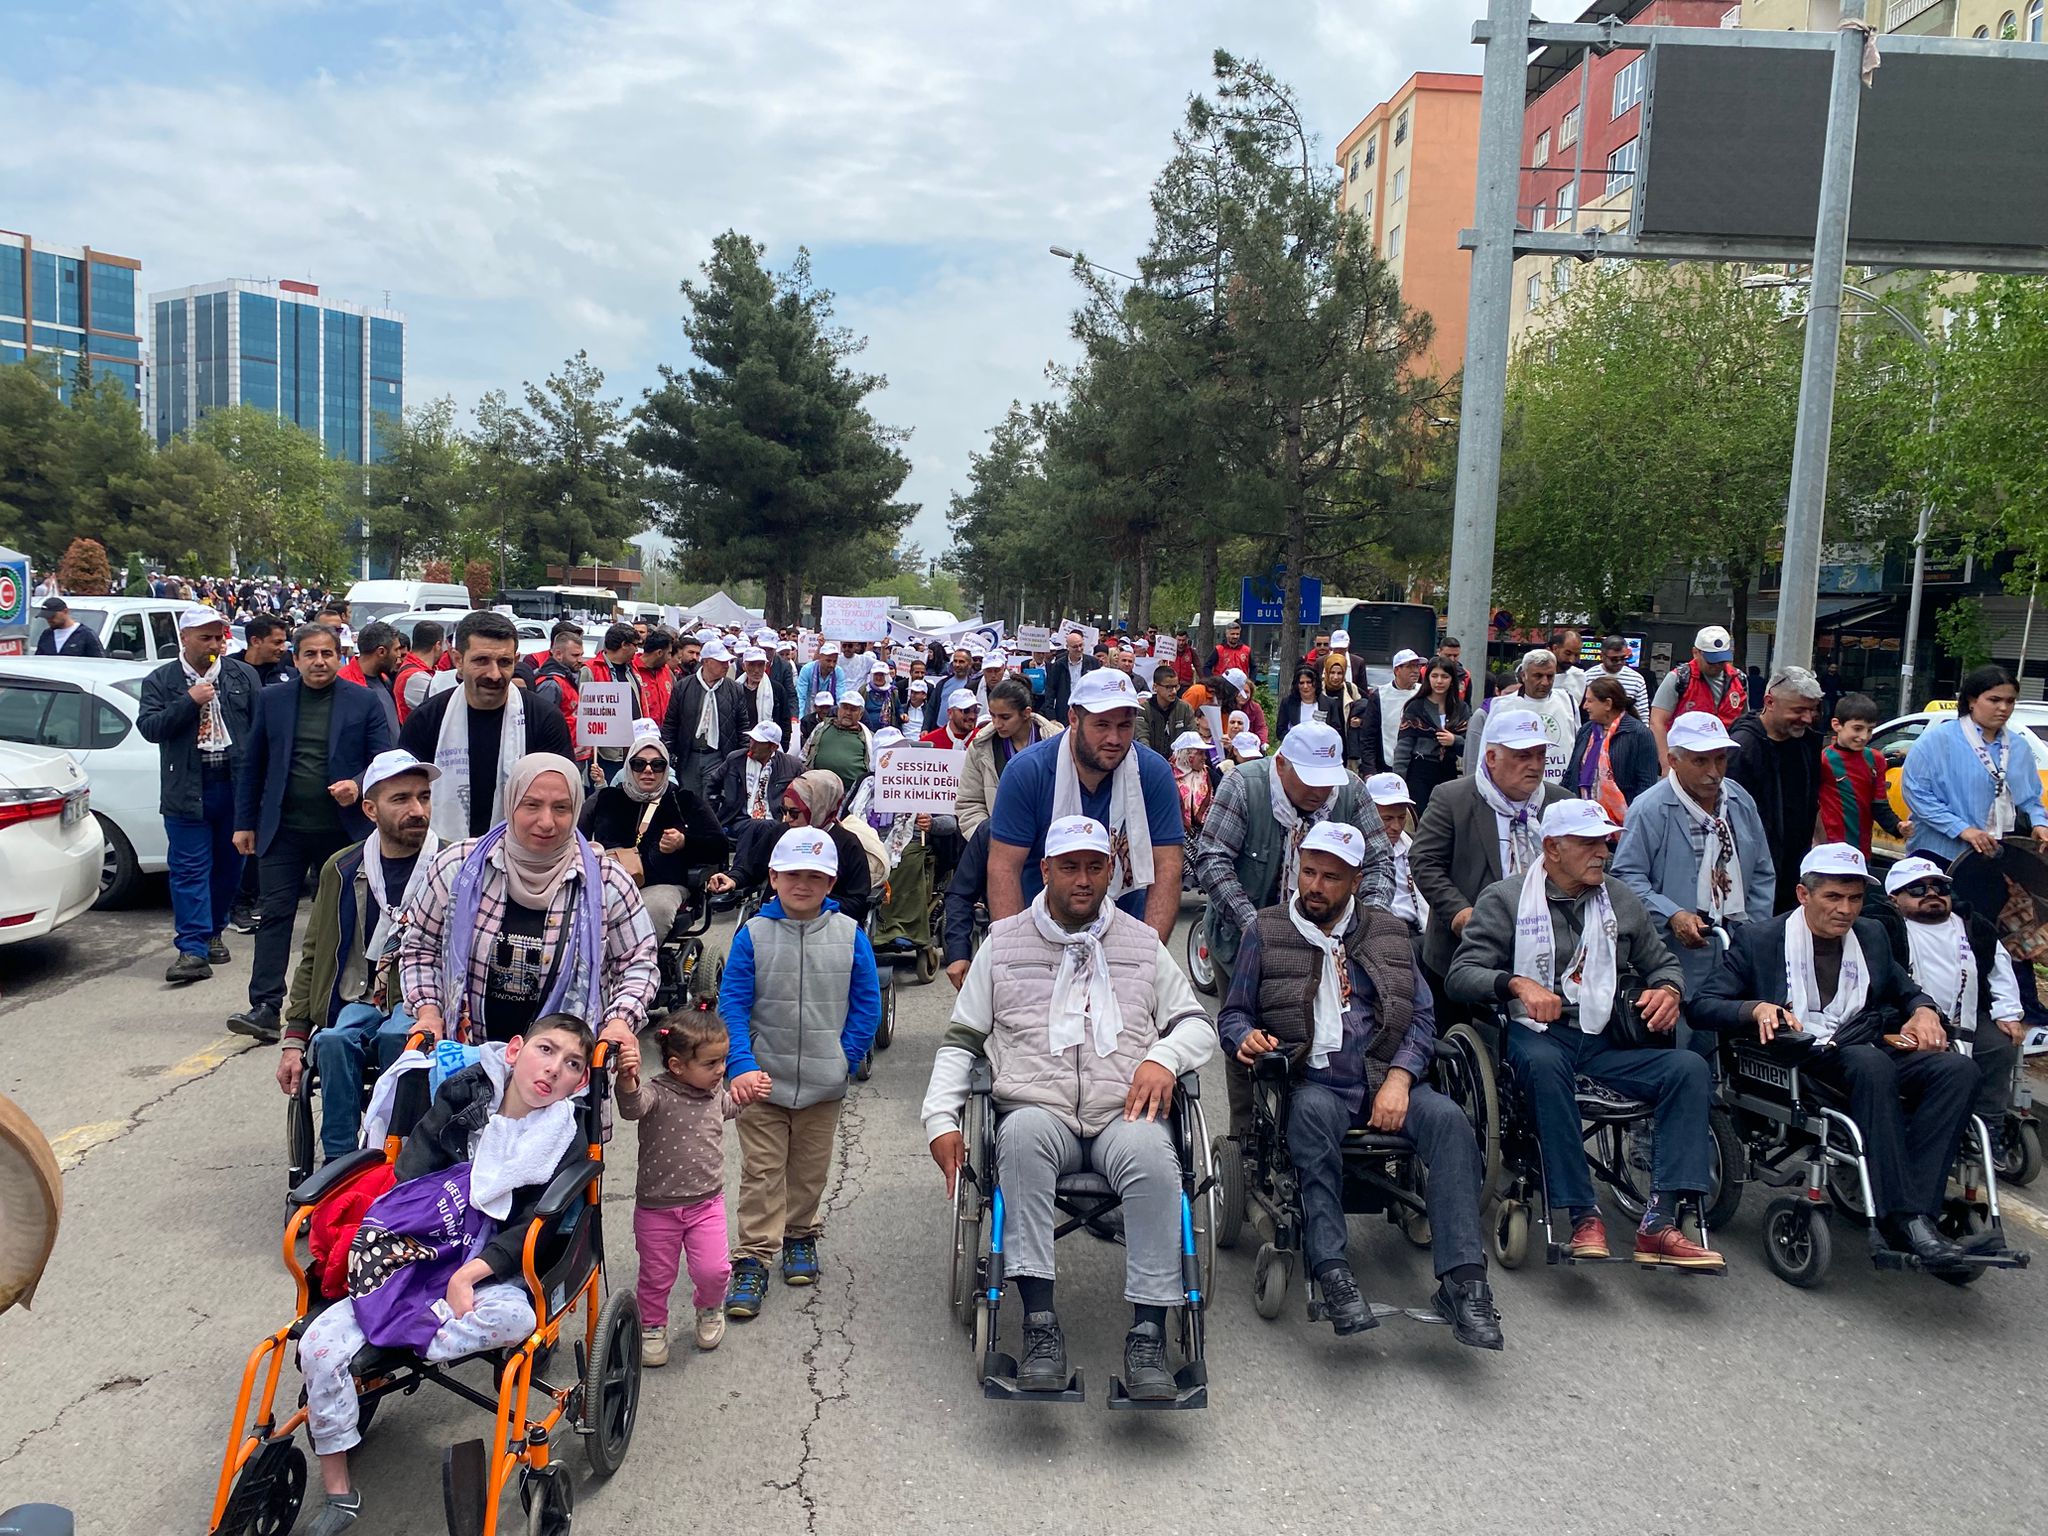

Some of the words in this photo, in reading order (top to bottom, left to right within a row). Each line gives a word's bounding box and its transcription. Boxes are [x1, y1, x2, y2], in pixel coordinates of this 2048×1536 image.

[1257, 609, 1307, 618] BULI
[596, 695, 605, 703] VE
[606, 692, 620, 703] VELİ
[587, 721, 608, 735] SON!
[896, 760, 949, 773] SESSİZLİK
[881, 773, 930, 786] EKSİKLİK
[882, 788, 901, 799] BİR
[904, 788, 957, 801] KİMLİKTİR
